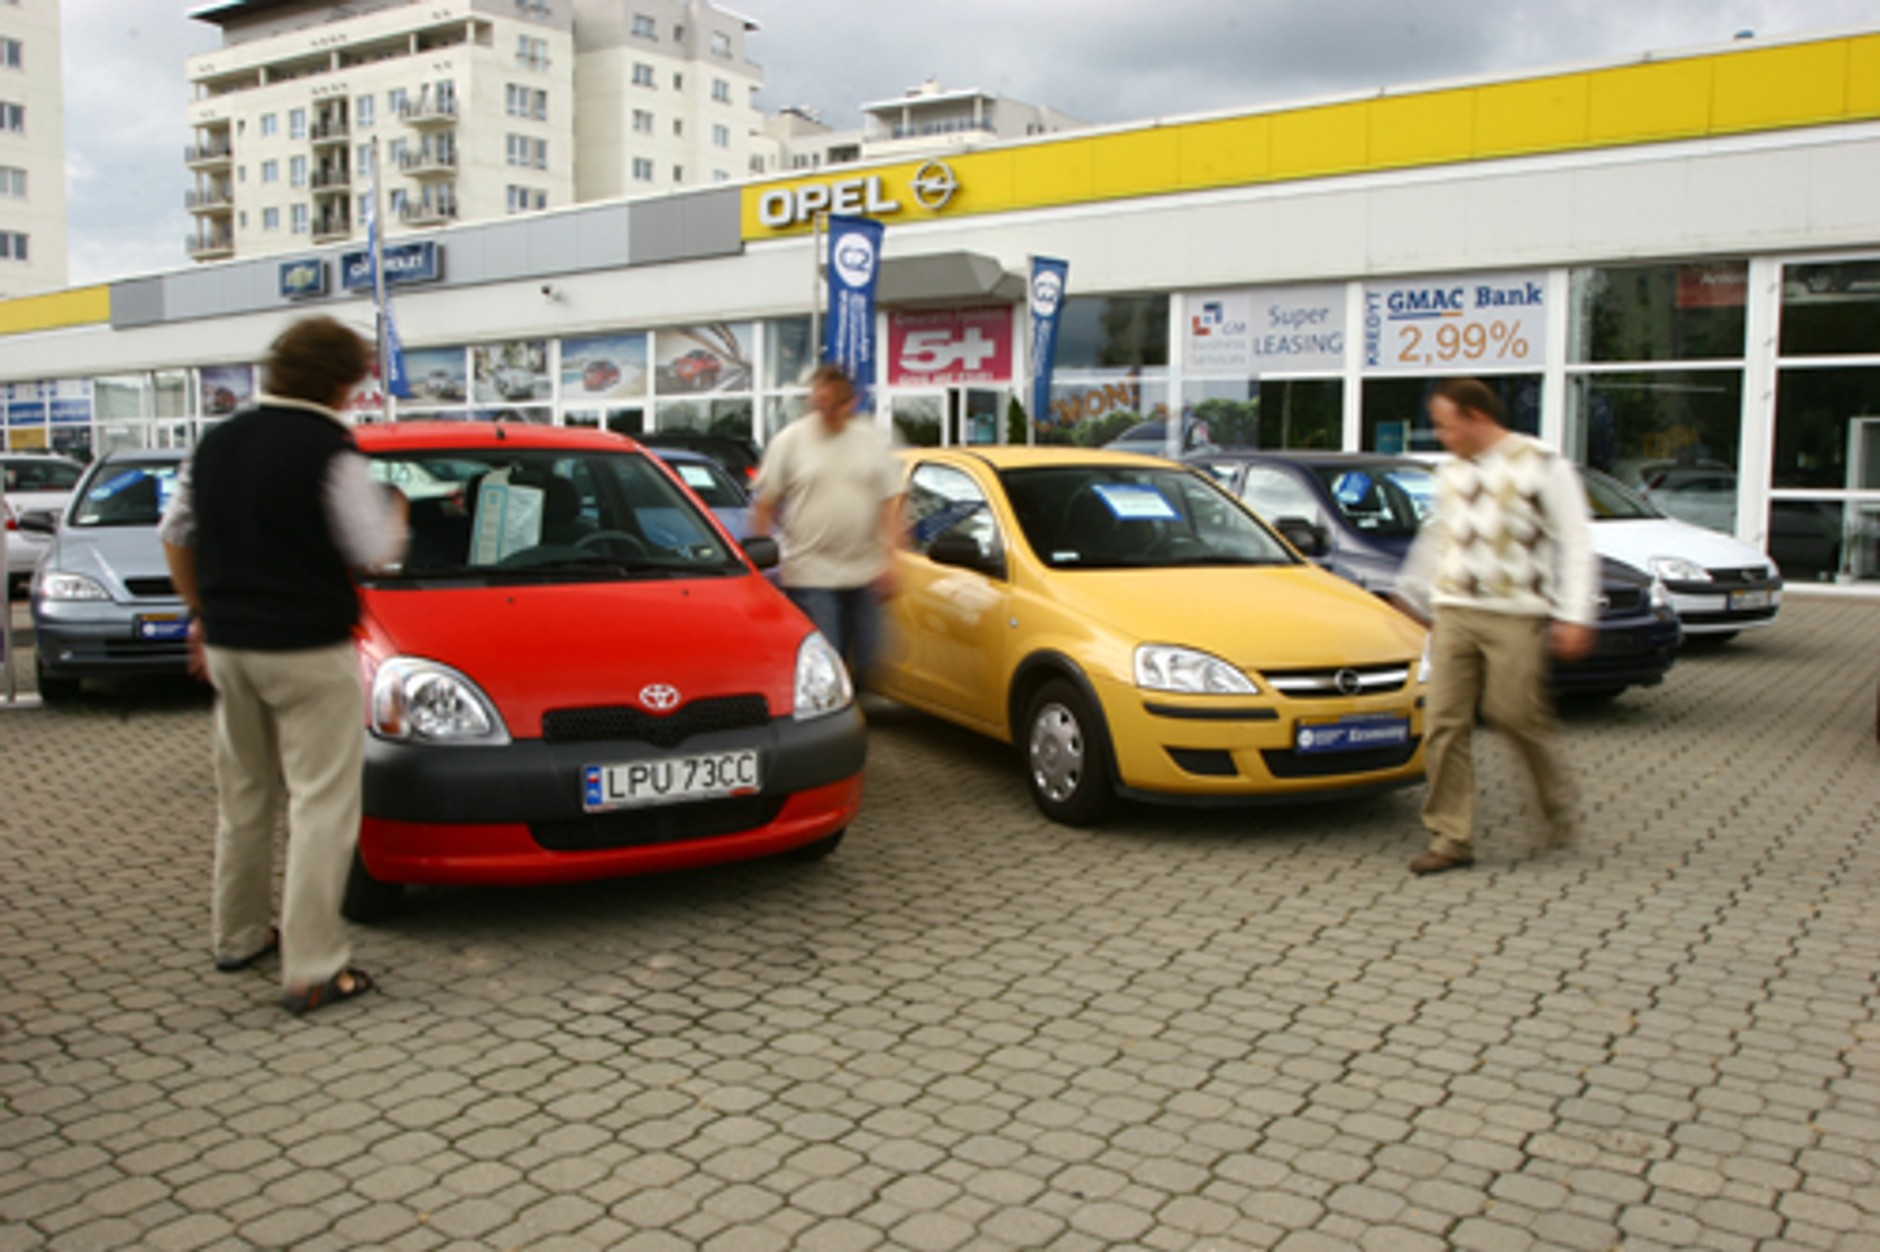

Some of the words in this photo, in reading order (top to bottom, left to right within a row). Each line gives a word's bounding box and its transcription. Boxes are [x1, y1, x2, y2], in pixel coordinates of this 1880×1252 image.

[759, 175, 900, 227] OPEL
[1387, 287, 1465, 313] GMAC
[1475, 282, 1543, 308] Bank
[1268, 305, 1330, 330] Super
[1253, 331, 1345, 356] LEASING
[1397, 319, 1530, 365] 2,99%
[607, 763, 674, 798] LPU
[684, 753, 754, 791] 73CC
